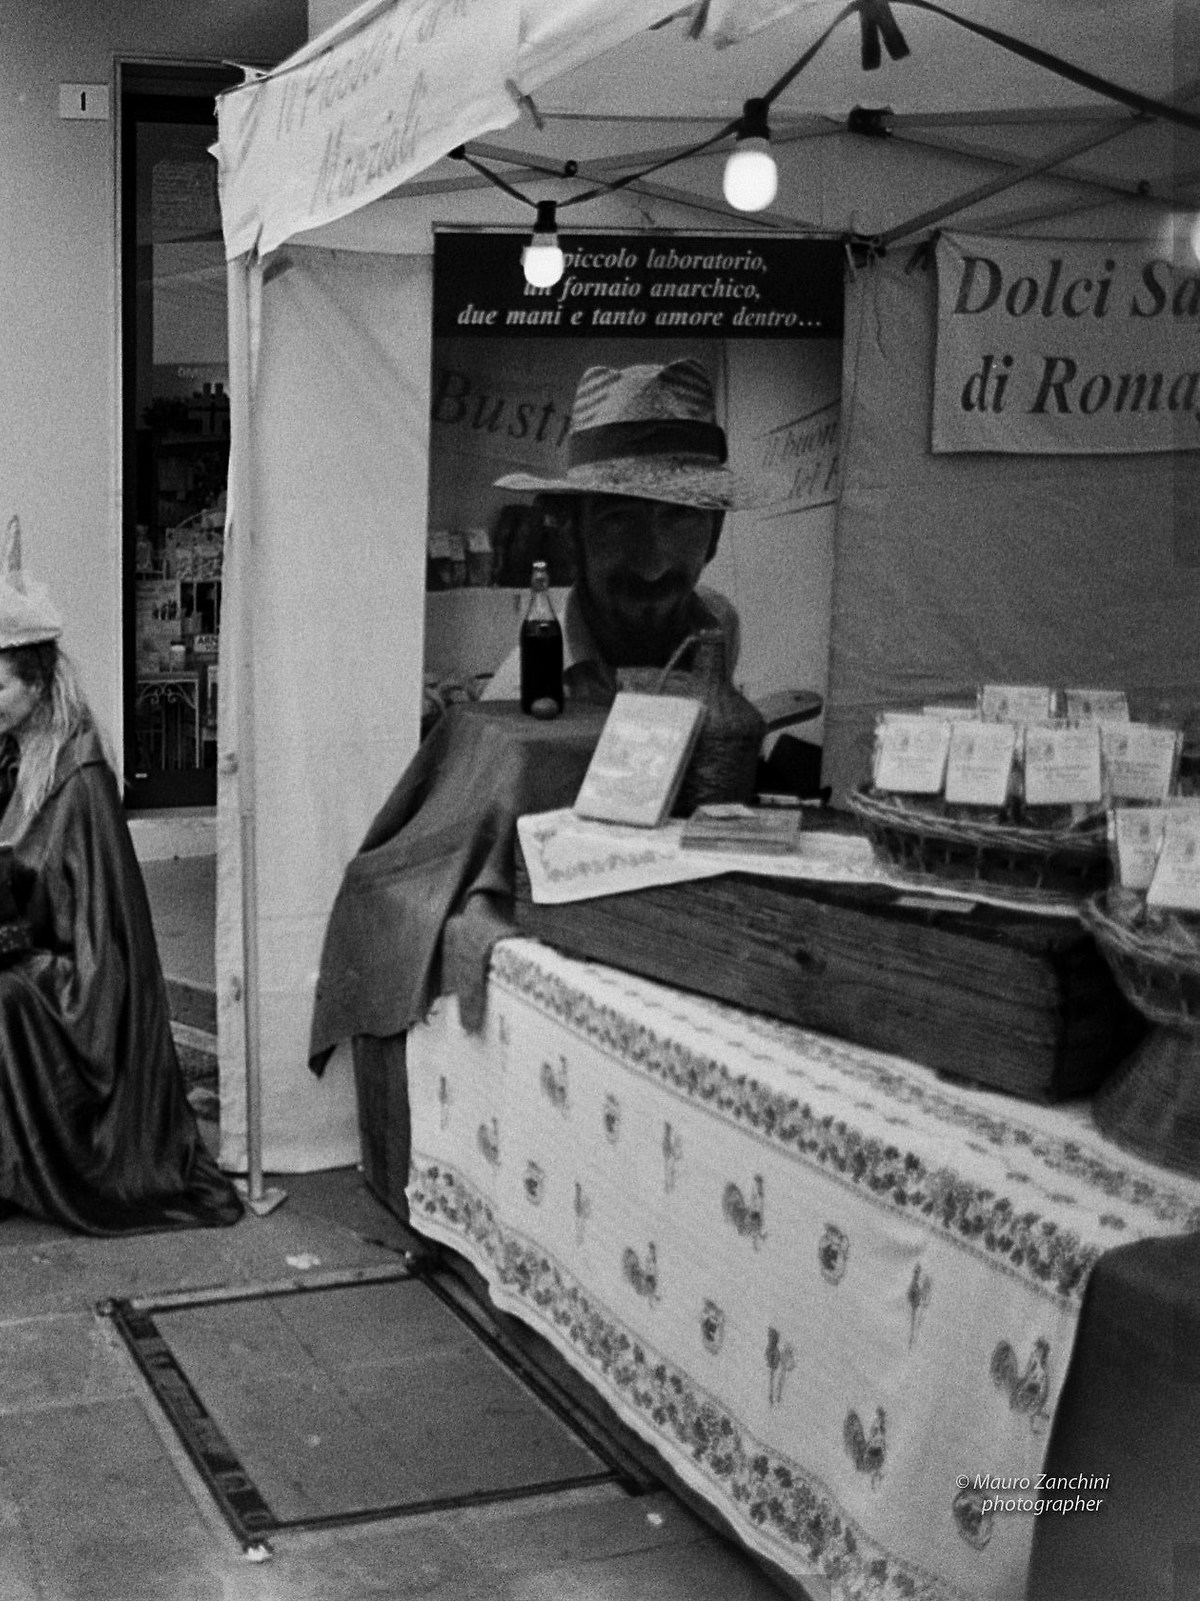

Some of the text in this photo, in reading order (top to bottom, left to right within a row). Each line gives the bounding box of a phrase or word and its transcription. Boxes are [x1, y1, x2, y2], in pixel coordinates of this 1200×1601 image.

[563, 248, 768, 275] piccolo laboratorio,
[557, 276, 642, 303] fornaio
[650, 277, 762, 300] anarchico,
[954, 255, 1200, 318] Dolci Sa
[457, 303, 822, 327] due mani e tanto amore dentro...
[961, 354, 1200, 416] di Roma
